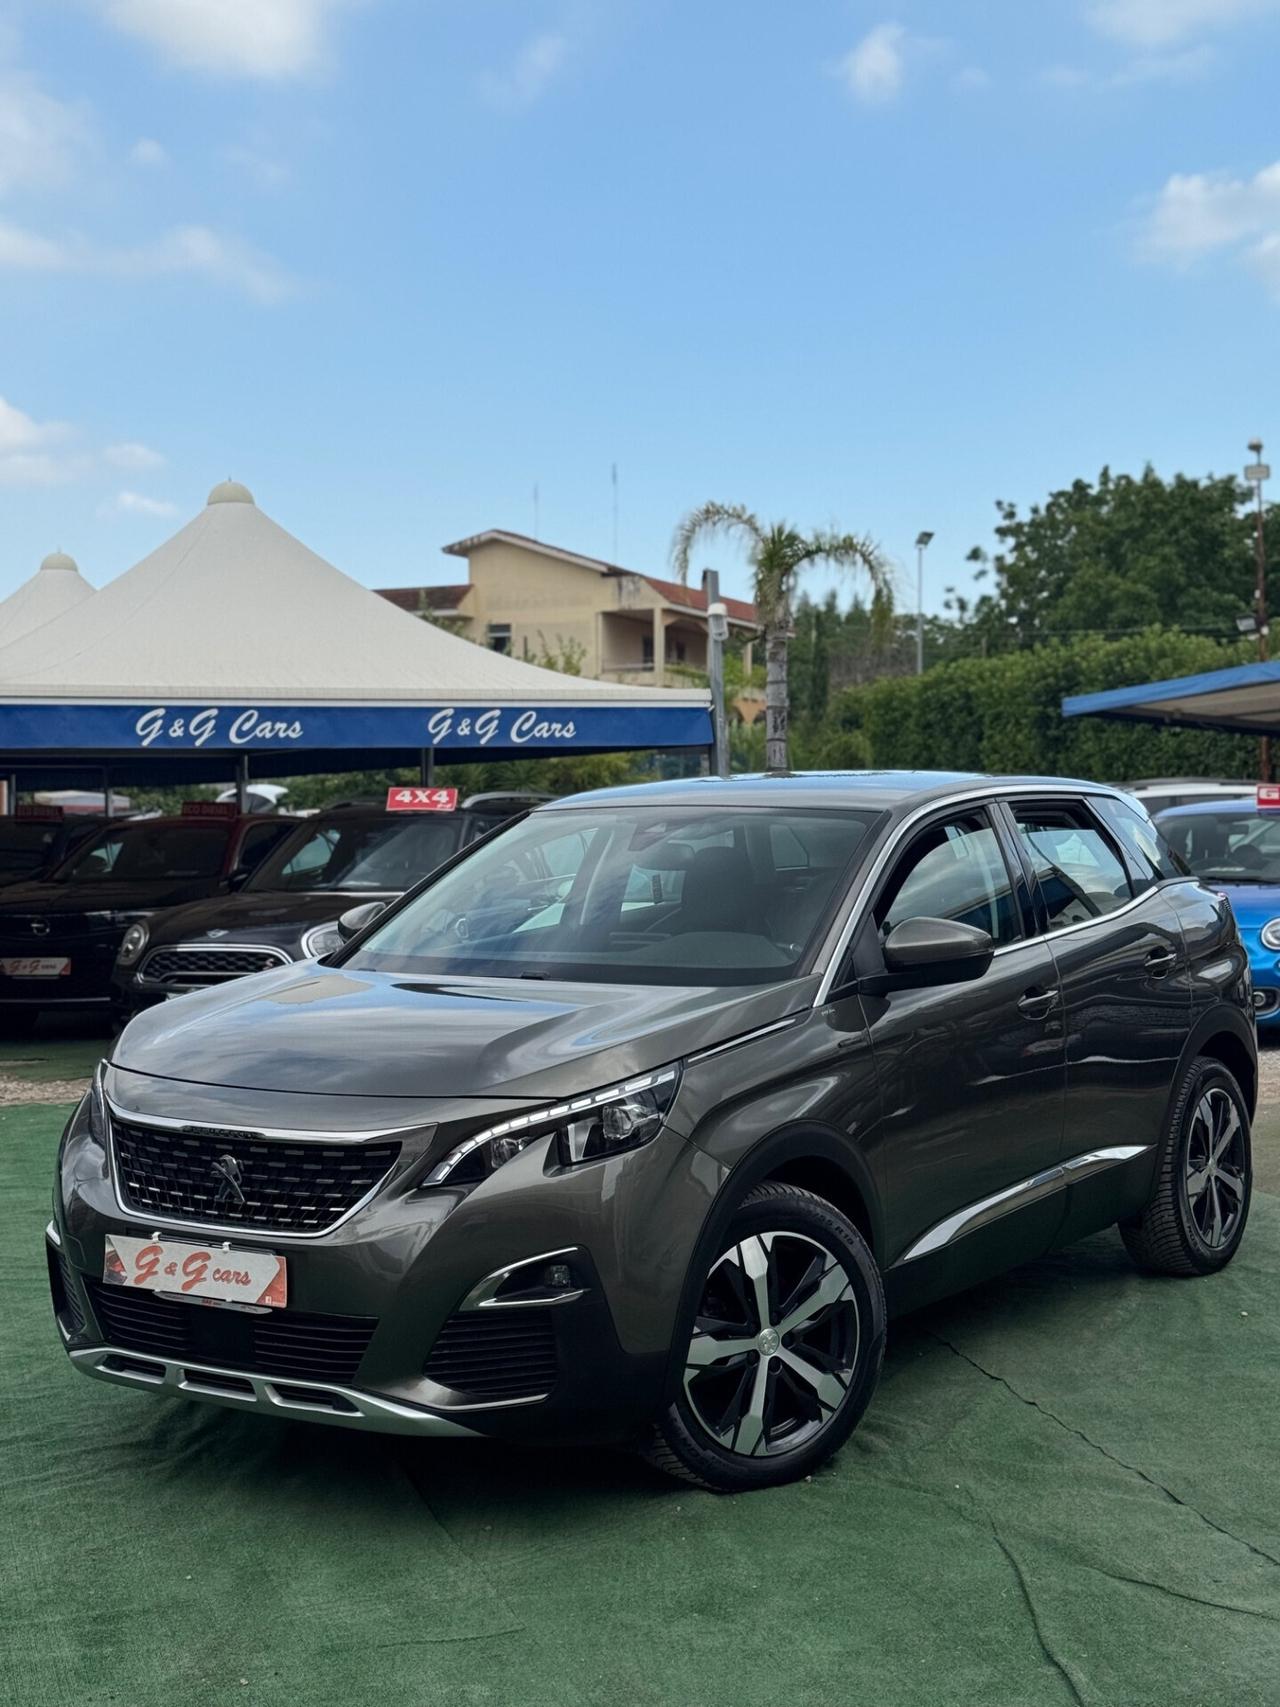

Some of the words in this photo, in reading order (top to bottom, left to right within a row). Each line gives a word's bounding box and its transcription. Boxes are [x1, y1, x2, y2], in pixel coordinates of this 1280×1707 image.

[228, 709, 304, 745] Cars
[509, 710, 577, 744] Cars
[212, 1267, 252, 1286] cars
